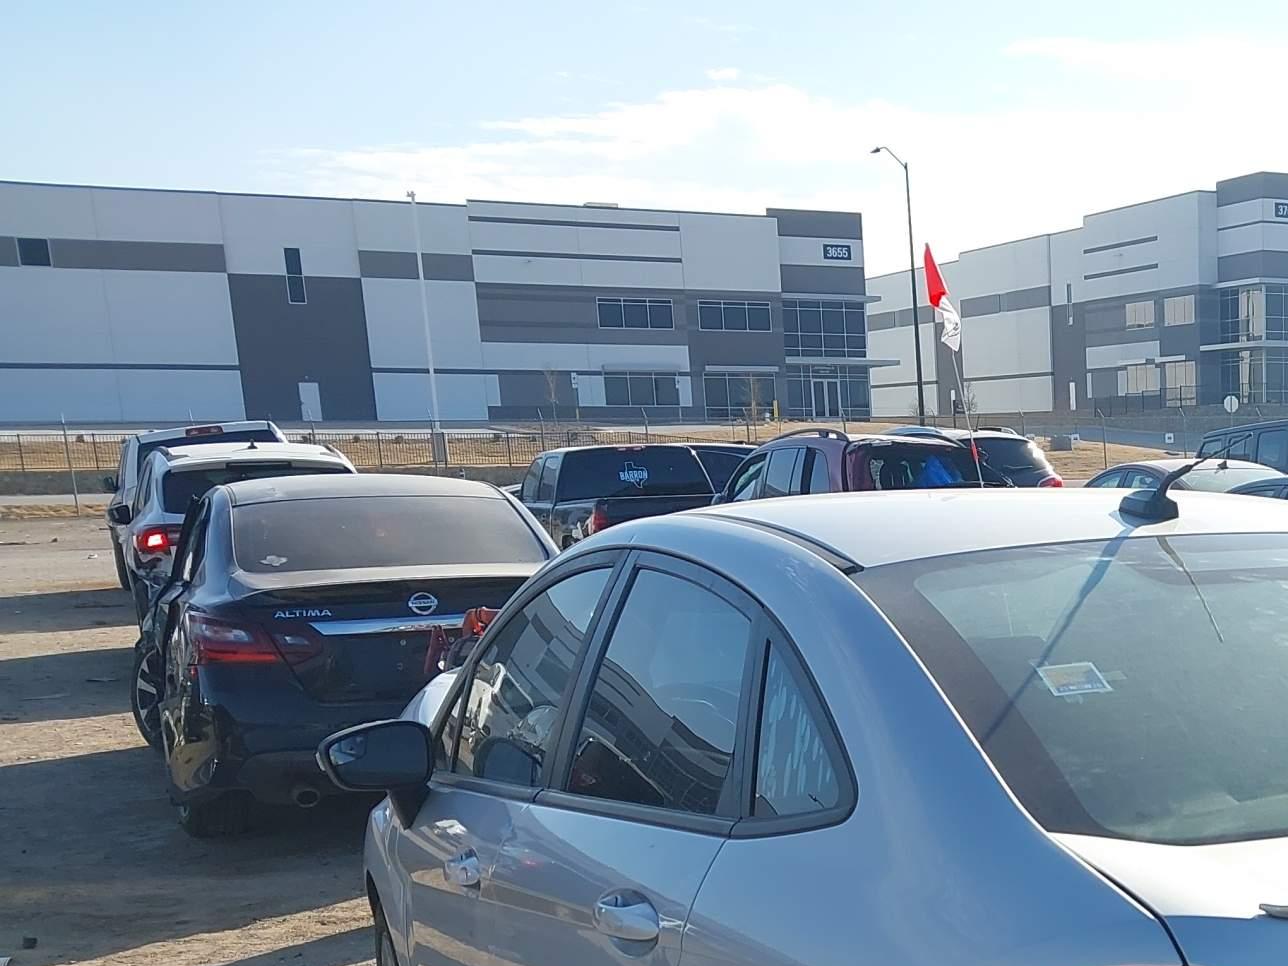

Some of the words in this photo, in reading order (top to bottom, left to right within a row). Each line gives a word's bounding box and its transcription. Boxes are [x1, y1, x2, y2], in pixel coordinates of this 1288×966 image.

[826, 246, 849, 258] 3655
[618, 470, 648, 481] BARRON
[274, 609, 332, 618] ALTIMA
